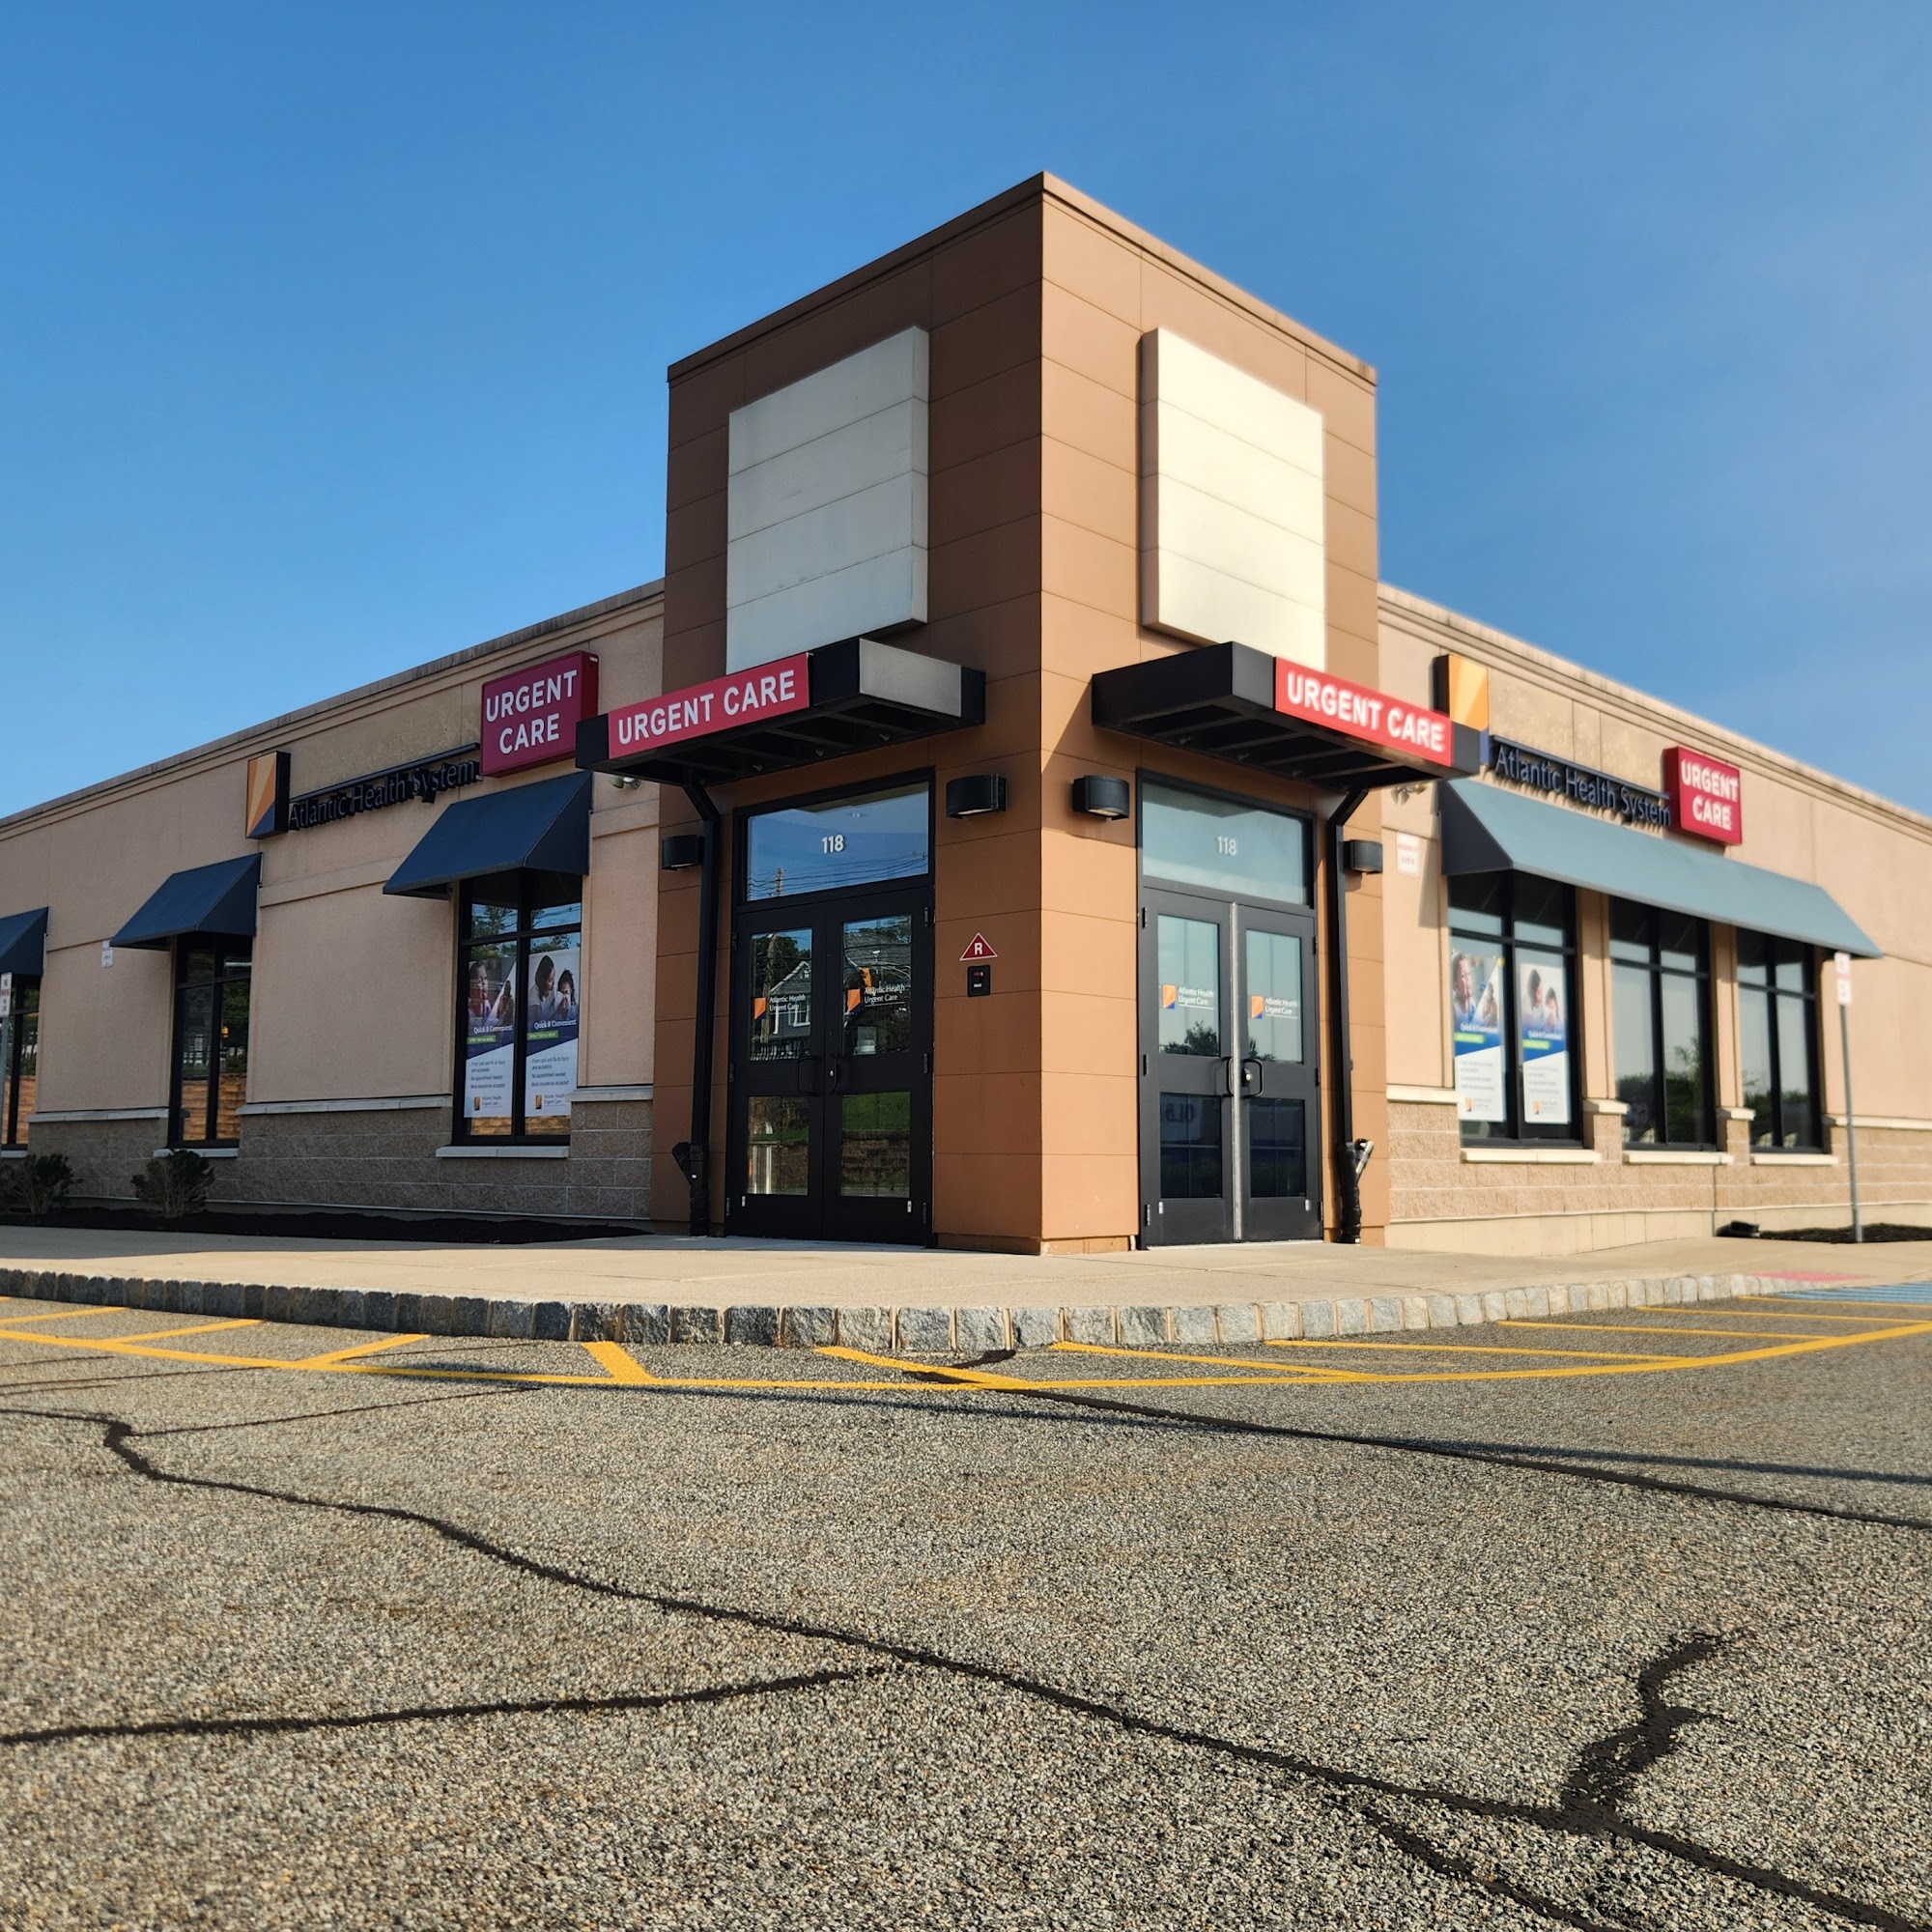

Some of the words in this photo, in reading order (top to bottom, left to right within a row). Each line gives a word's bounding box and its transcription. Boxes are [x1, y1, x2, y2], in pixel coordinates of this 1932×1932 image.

[486, 669, 577, 723] URGENT
[618, 693, 714, 744] URGENT
[724, 669, 796, 715] CARE
[1287, 670, 1383, 730] URGENT
[1387, 706, 1446, 753] CARE
[499, 713, 559, 754] CARE
[1495, 744, 1562, 792] Atlantic
[1565, 766, 1616, 810] Health
[1620, 785, 1671, 827] System
[1681, 758, 1739, 803] URGENT
[291, 793, 347, 829] Atlantic
[352, 772, 406, 813] Health
[412, 760, 474, 801] System
[1692, 794, 1732, 832] CARE
[822, 834, 844, 854] 118
[1217, 836, 1237, 856] 118
[974, 942, 983, 955] R
[789, 994, 806, 1002] Health
[887, 983, 905, 993] Health
[1178, 986, 1197, 996] Atlantic
[1197, 988, 1214, 997] Health
[788, 1002, 799, 1010] Care
[864, 994, 883, 1005] Urgent
[884, 994, 898, 1002] Care
[1178, 995, 1195, 1005] Urgent
[1196, 997, 1208, 1006] Care
[1265, 997, 1282, 1006] Atlantic
[1282, 999, 1298, 1008] Health
[1265, 1006, 1281, 1014] Urgent
